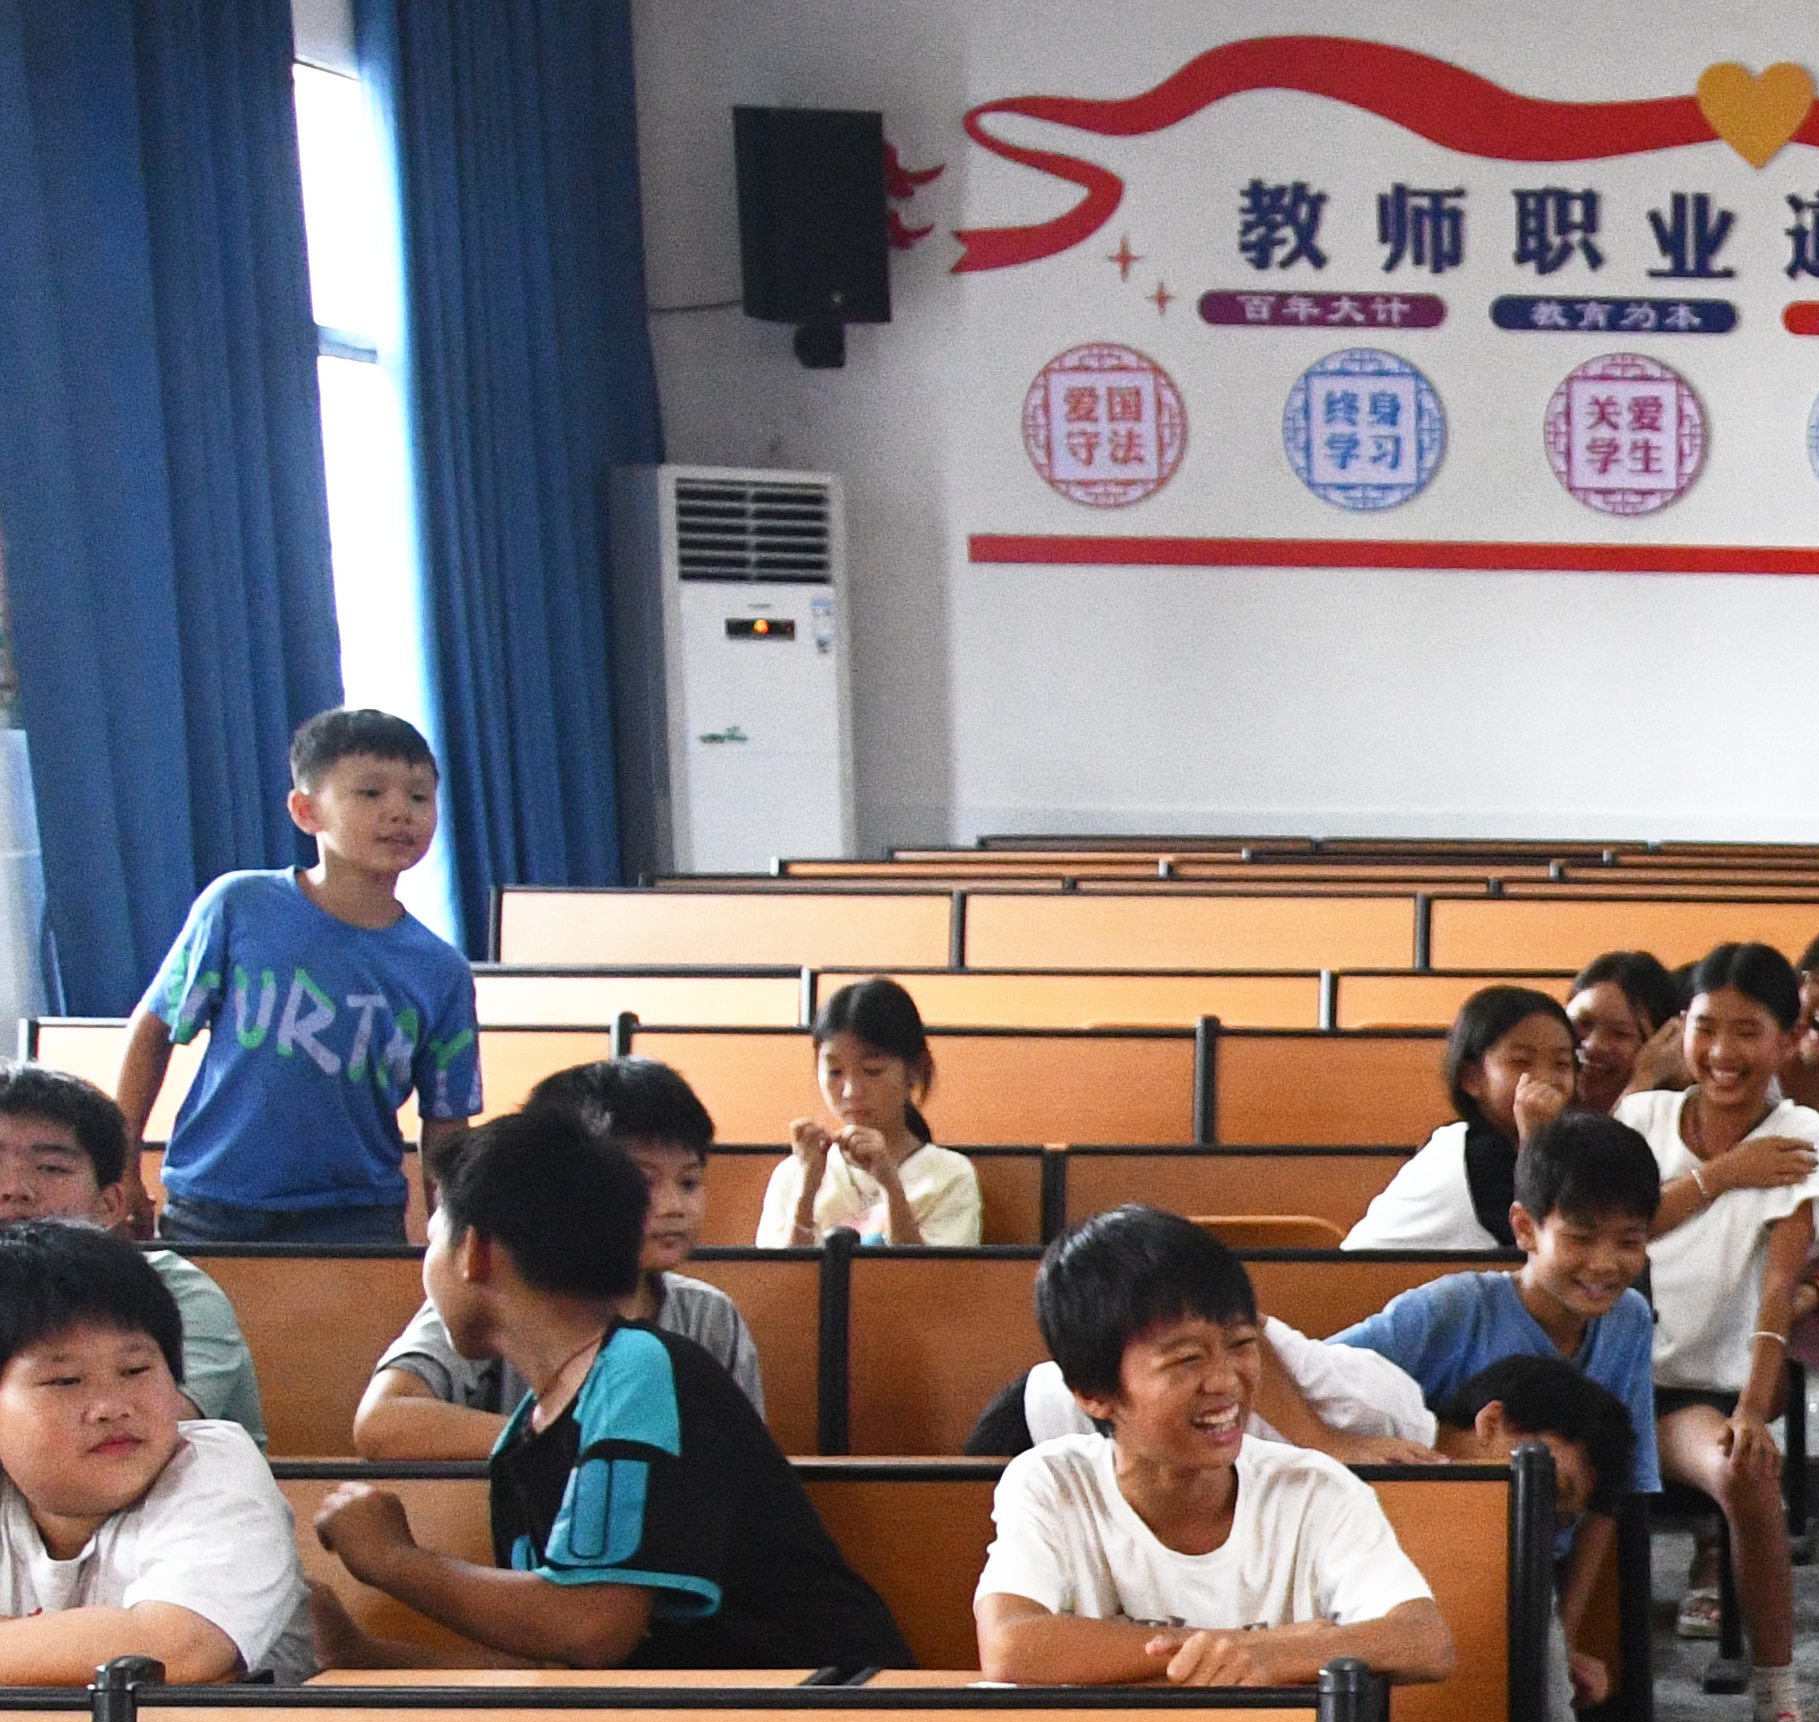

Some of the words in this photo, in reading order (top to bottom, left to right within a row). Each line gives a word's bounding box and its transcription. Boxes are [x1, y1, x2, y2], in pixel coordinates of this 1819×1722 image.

[1236, 294, 1410, 325] 百年大计
[1530, 301, 1703, 330] 教育为本
